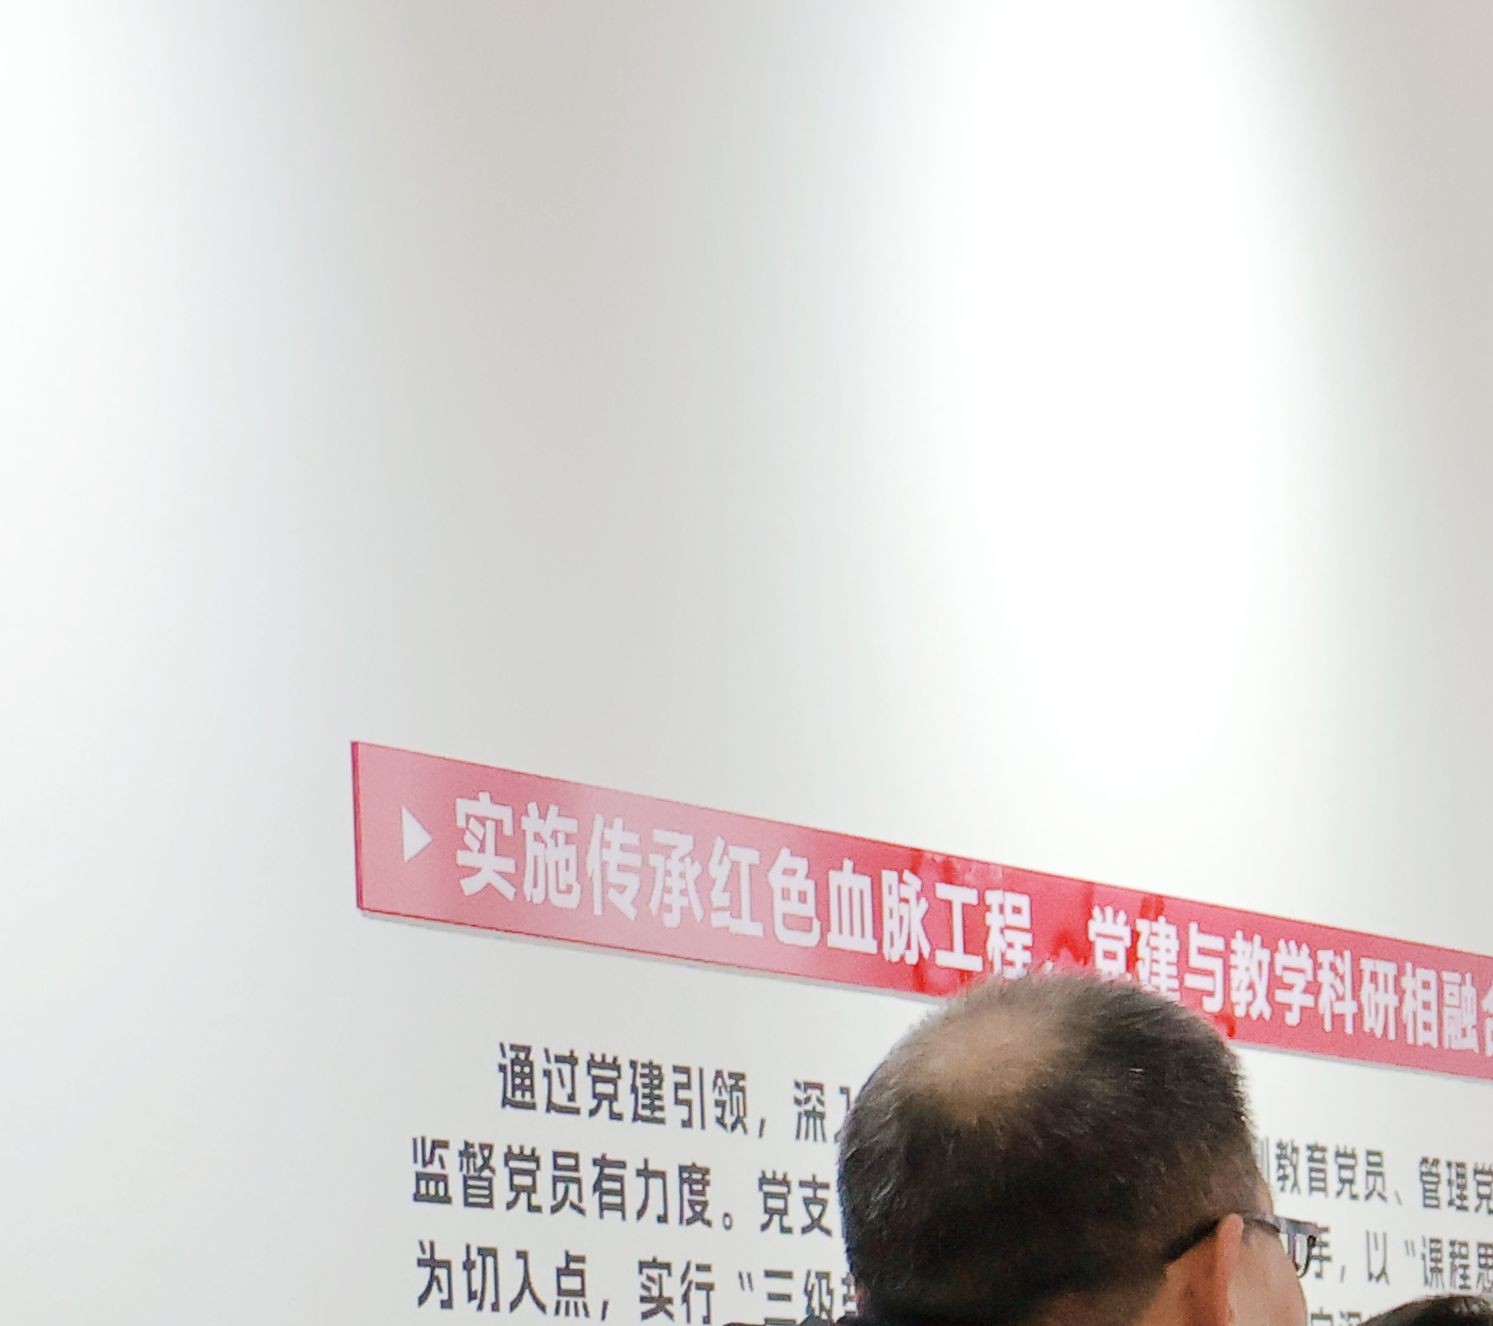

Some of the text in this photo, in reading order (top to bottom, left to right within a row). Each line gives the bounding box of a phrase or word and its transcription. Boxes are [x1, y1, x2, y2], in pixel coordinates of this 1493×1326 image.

[412, 1134, 848, 1240] 监督党员有力度。党支
